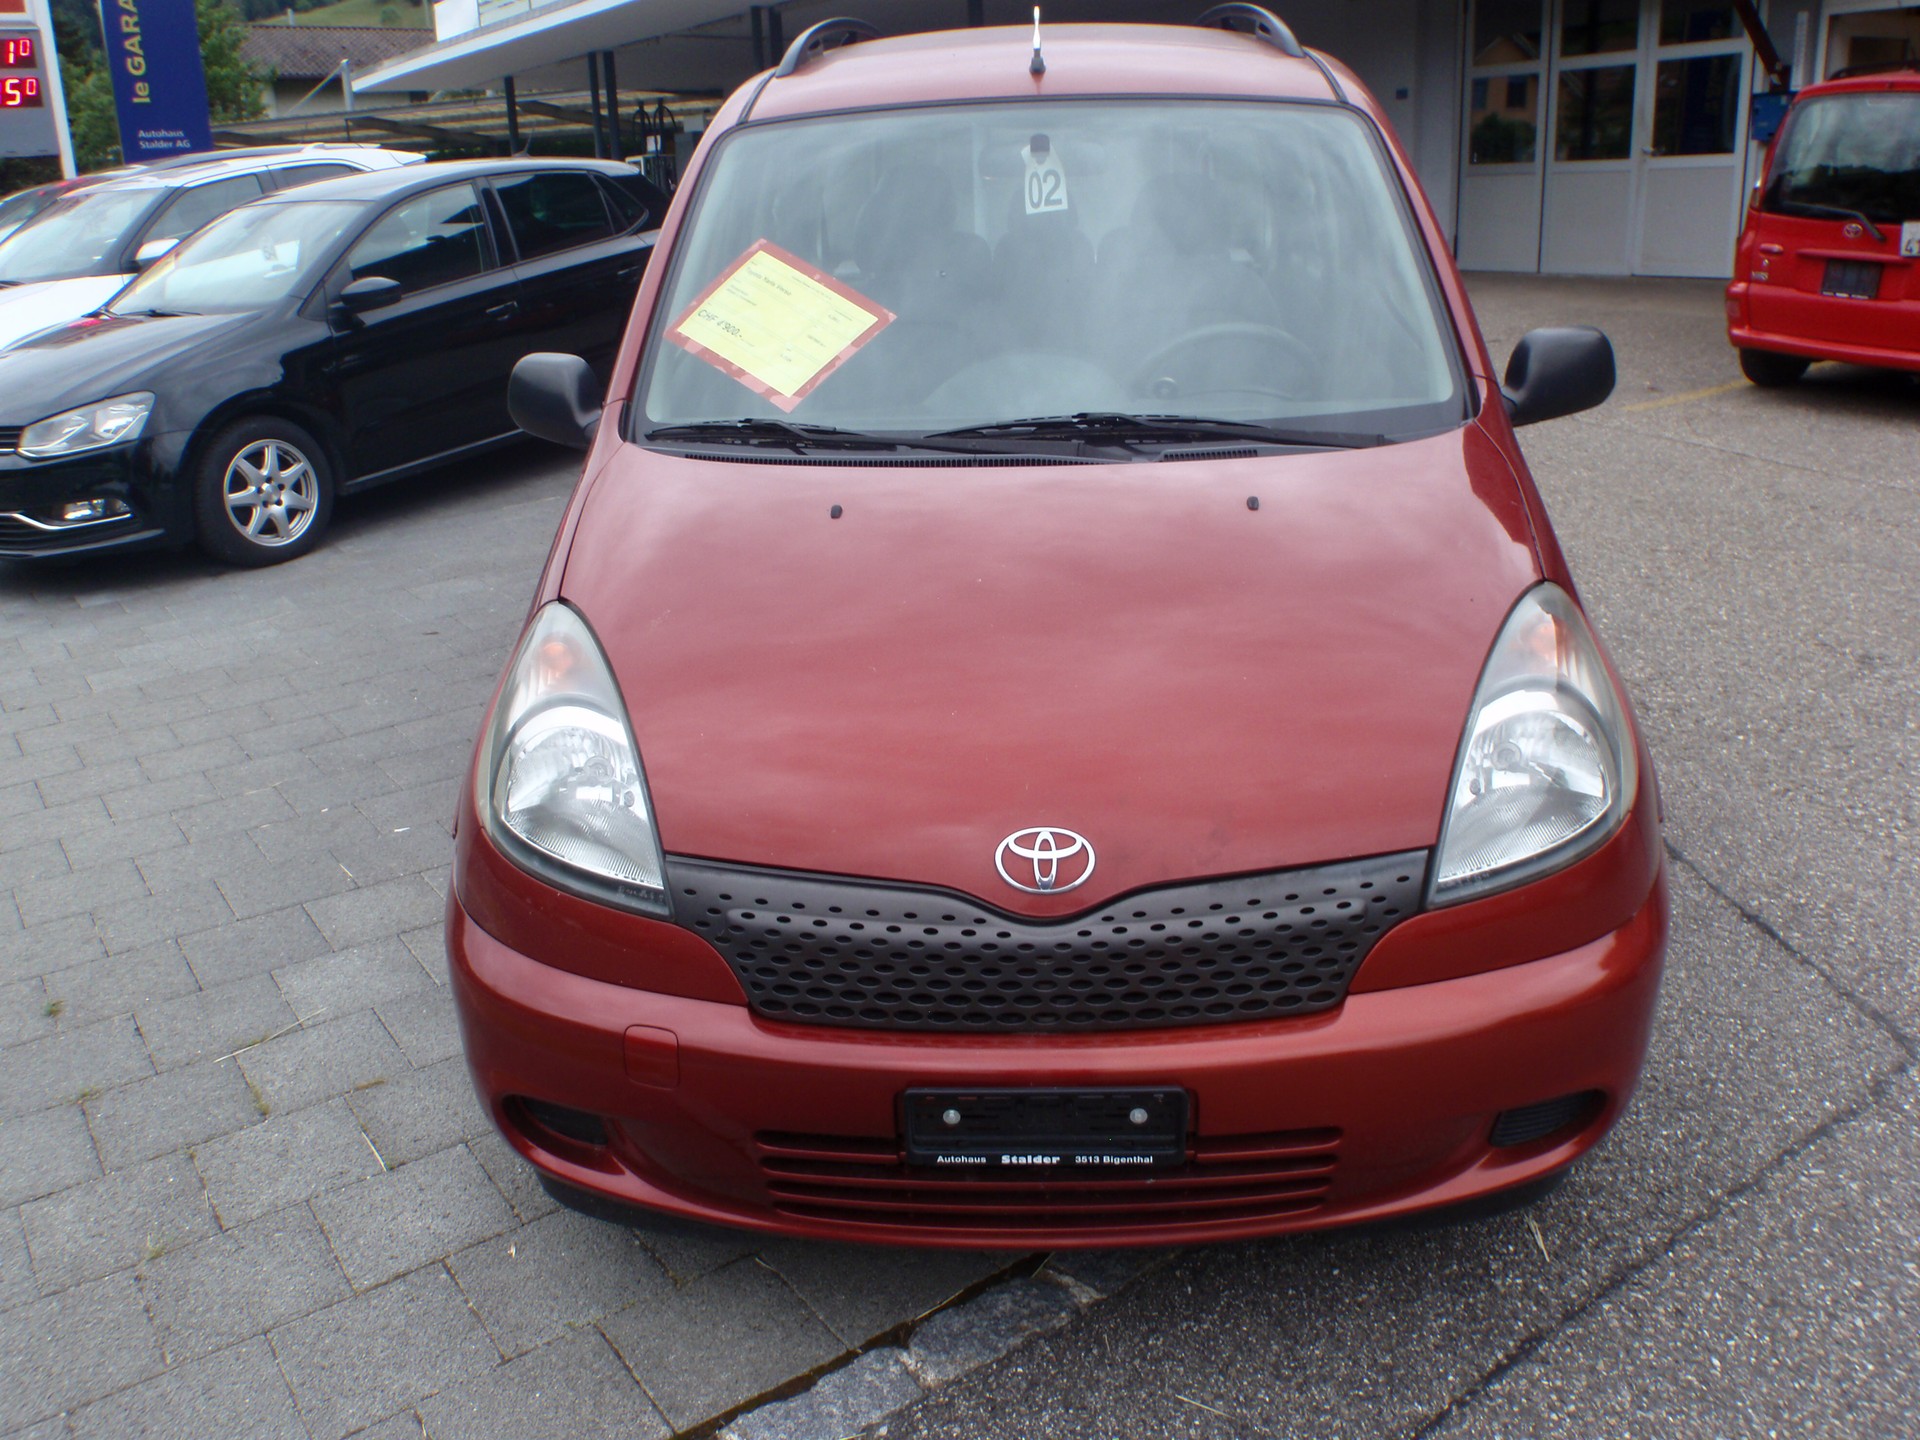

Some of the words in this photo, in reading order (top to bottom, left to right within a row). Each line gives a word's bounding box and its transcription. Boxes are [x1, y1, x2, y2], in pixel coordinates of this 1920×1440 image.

[132, 82, 150, 103] le
[138, 129, 184, 138] Autohaus
[139, 139, 173, 149] Stalder
[176, 139, 191, 148] AG
[1028, 169, 1063, 209] 02
[698, 309, 719, 321] CHF
[937, 1155, 987, 1163] Autohaus
[1001, 1154, 1060, 1164] Stalder
[1075, 1155, 1100, 1164] 3513
[1103, 1155, 1153, 1165] Bigenthal
